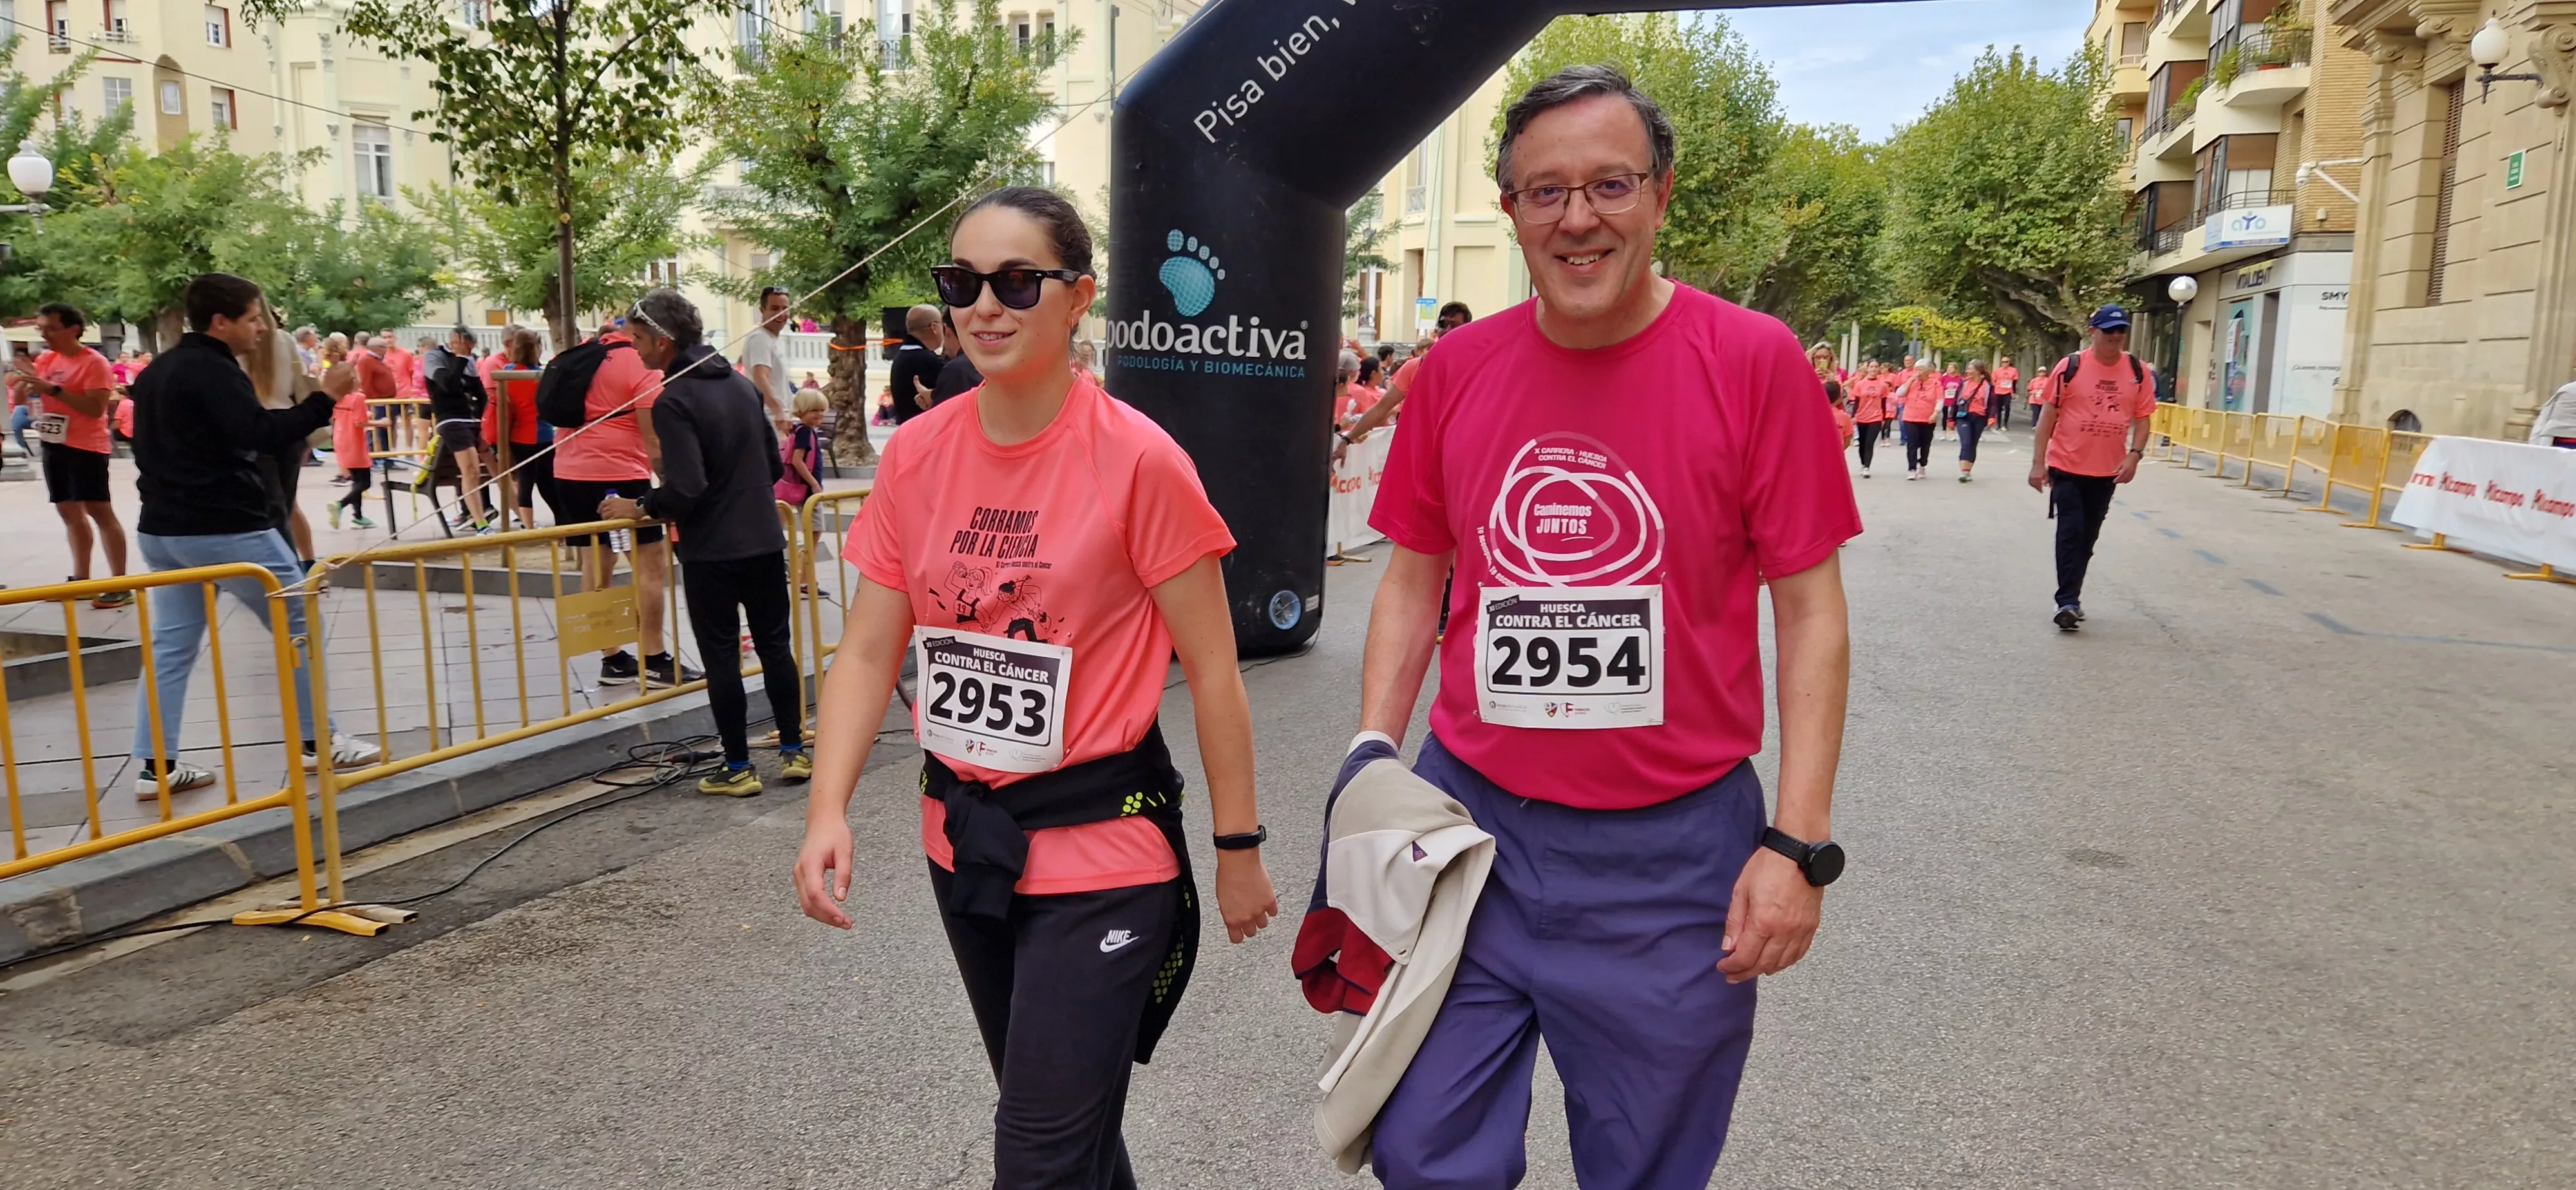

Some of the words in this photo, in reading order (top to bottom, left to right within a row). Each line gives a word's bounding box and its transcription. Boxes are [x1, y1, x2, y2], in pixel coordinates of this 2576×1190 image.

[1193, 79, 1265, 144] Pisa
[1257, 15, 1340, 82] bien,
[1118, 355, 1184, 372] PODOLOGÍA
[1190, 361, 1199, 372] Y
[1205, 361, 1305, 378] BIOMECÁNICA
[1579, 450, 1607, 462] HUESCA
[1534, 502, 1593, 517] Caminemos
[970, 507, 1039, 534] CORRAMOS
[1536, 518, 1587, 534] JUNTOS
[949, 530, 980, 555] POR
[978, 533, 997, 558] LA
[997, 534, 1039, 559] CIENCIA
[958, 603, 967, 614] 19
[1495, 598, 1517, 610] EDICIÓN
[1540, 603, 1586, 613] HUESCA
[1495, 614, 1552, 628] CONTRA
[1555, 615, 1573, 628] EL
[1577, 612, 1642, 628] CÁNCER
[933, 638, 954, 647] EDICIÓN
[973, 647, 1007, 662] HUESCA
[1492, 636, 1646, 687] 2954
[934, 651, 981, 670] CONTRA
[983, 661, 996, 674] EL
[998, 663, 1049, 683] CÁNCER
[930, 672, 1046, 737] 2953
[1106, 930, 1132, 943] NIKE
